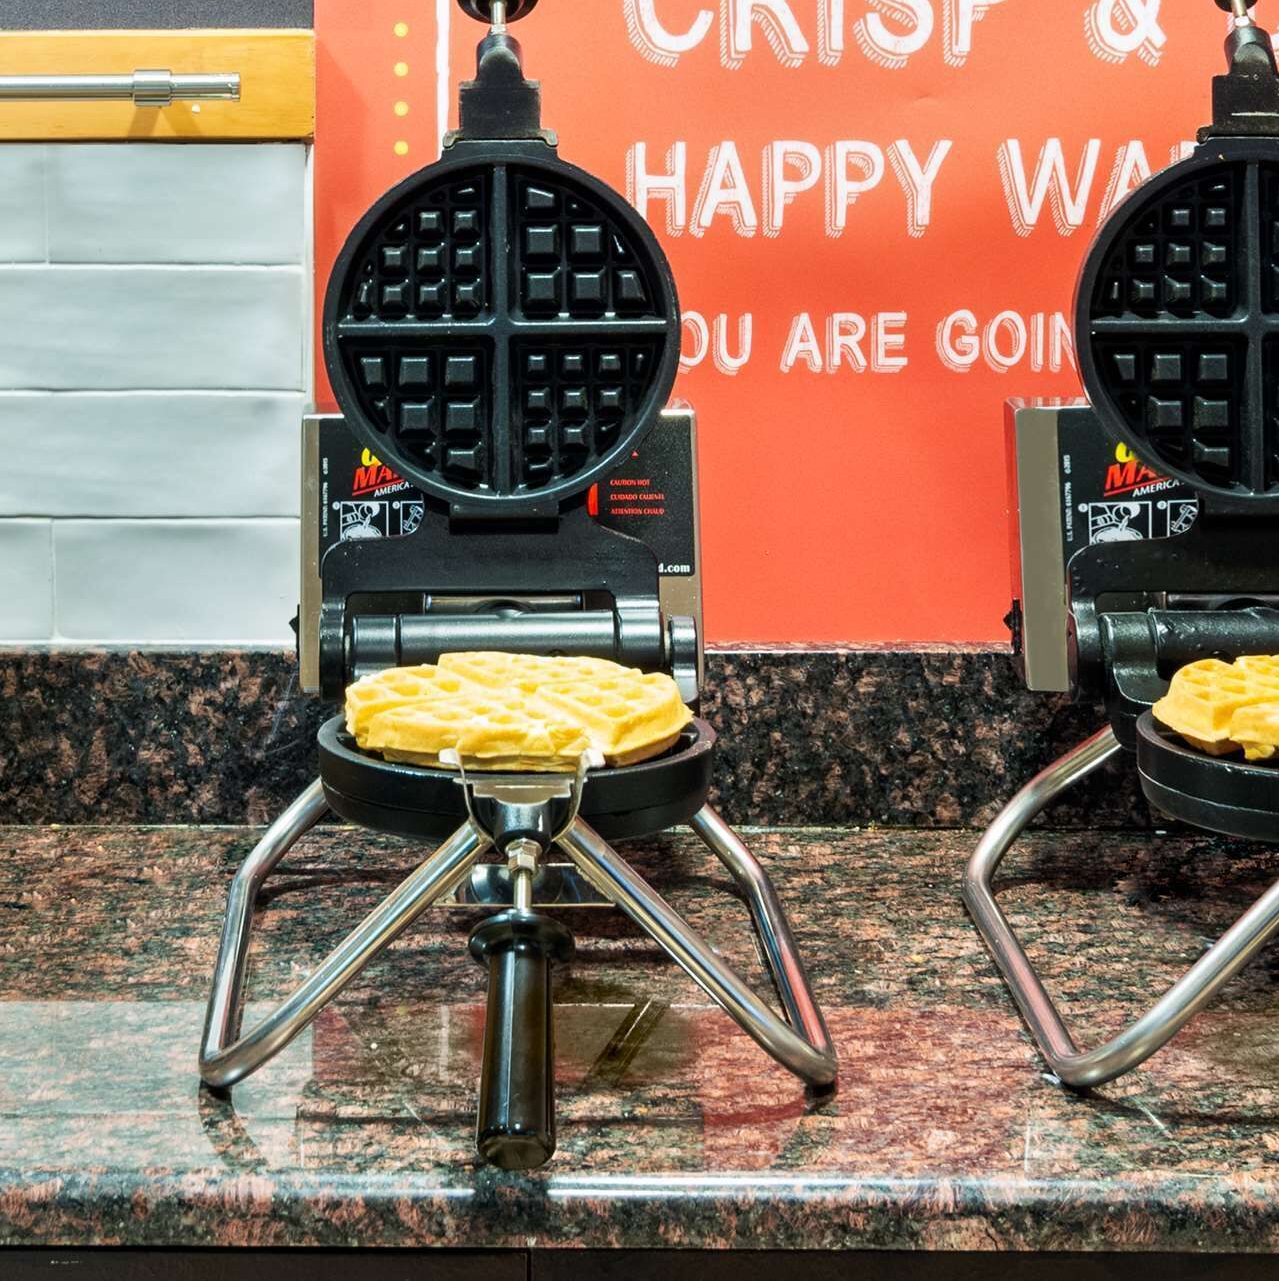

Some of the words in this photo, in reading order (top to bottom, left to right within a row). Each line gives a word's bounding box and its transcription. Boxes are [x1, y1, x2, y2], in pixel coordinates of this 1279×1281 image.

[626, 139, 953, 239] HAPPY
[678, 309, 753, 376] OU
[779, 309, 908, 374] ARE
[935, 309, 1077, 374] GOIN
